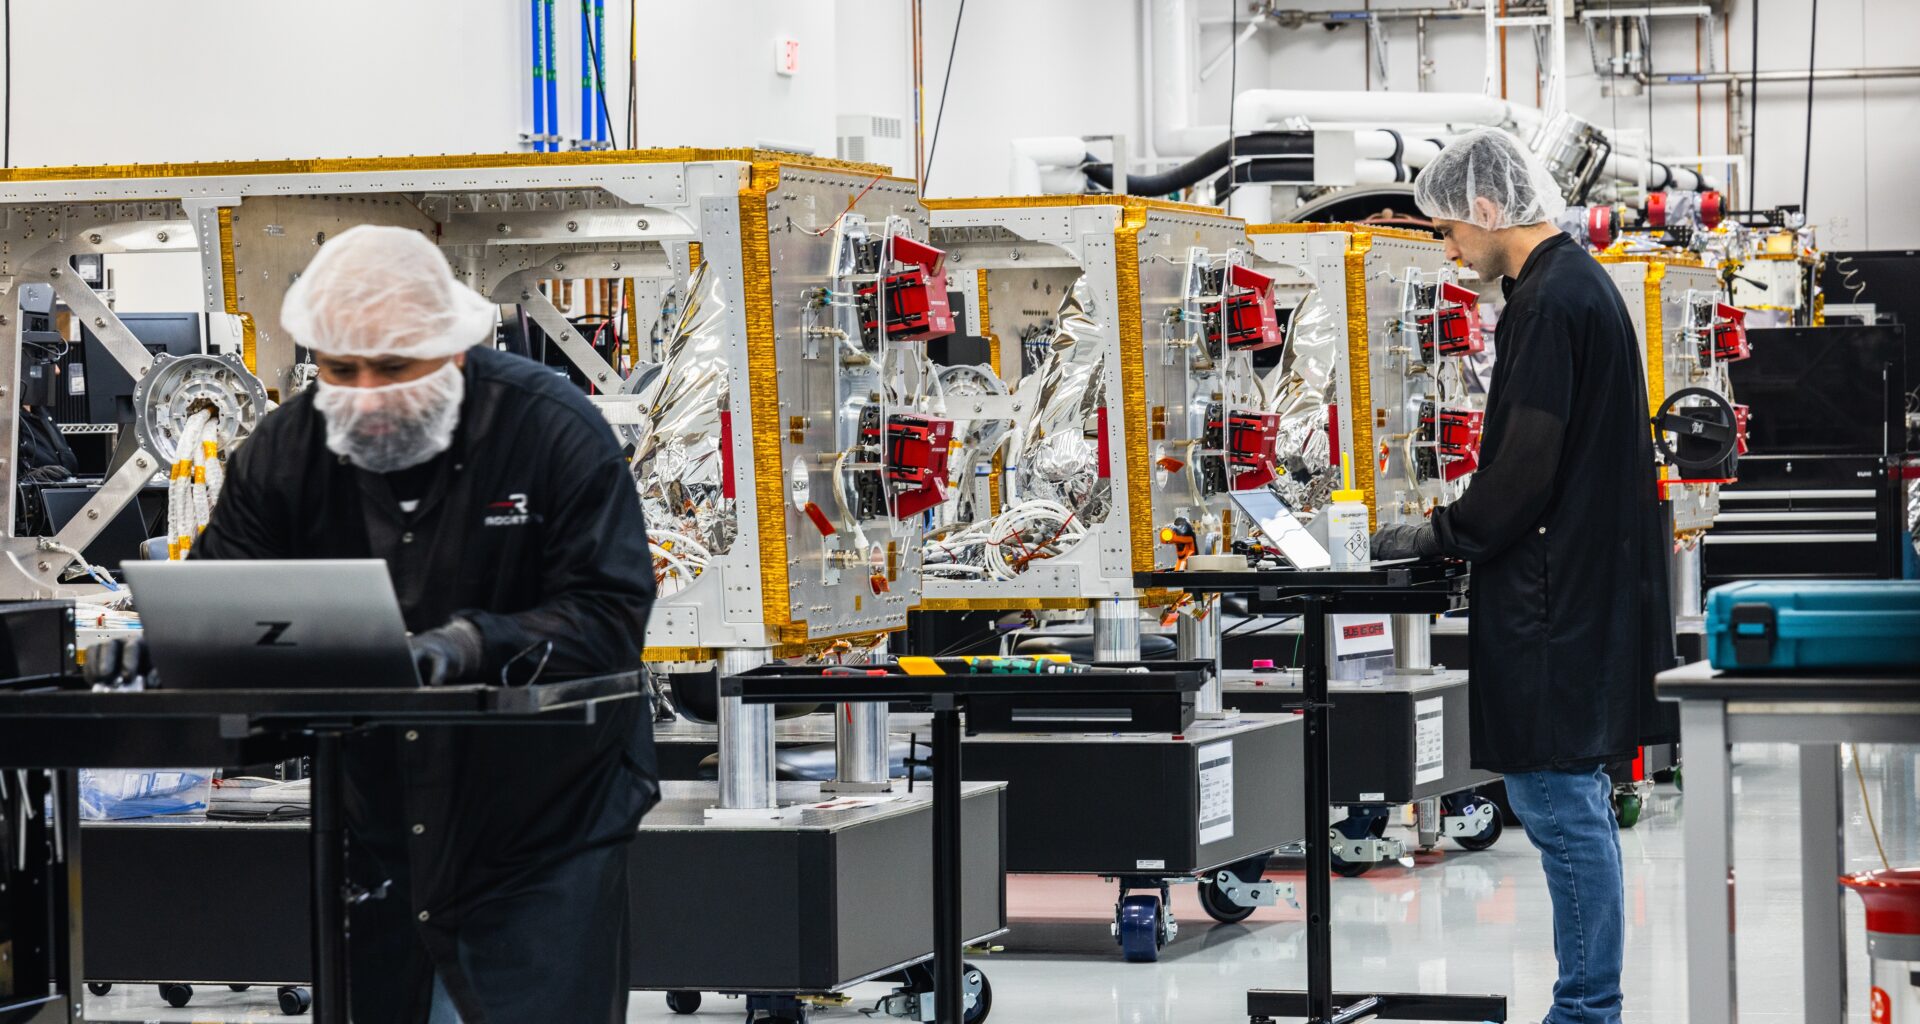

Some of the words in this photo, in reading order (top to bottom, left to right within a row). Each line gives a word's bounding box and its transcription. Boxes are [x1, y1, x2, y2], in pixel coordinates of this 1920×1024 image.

[484, 515, 528, 526] ROCET
[1356, 533, 1362, 542] 3
[255, 621, 298, 646] Z
